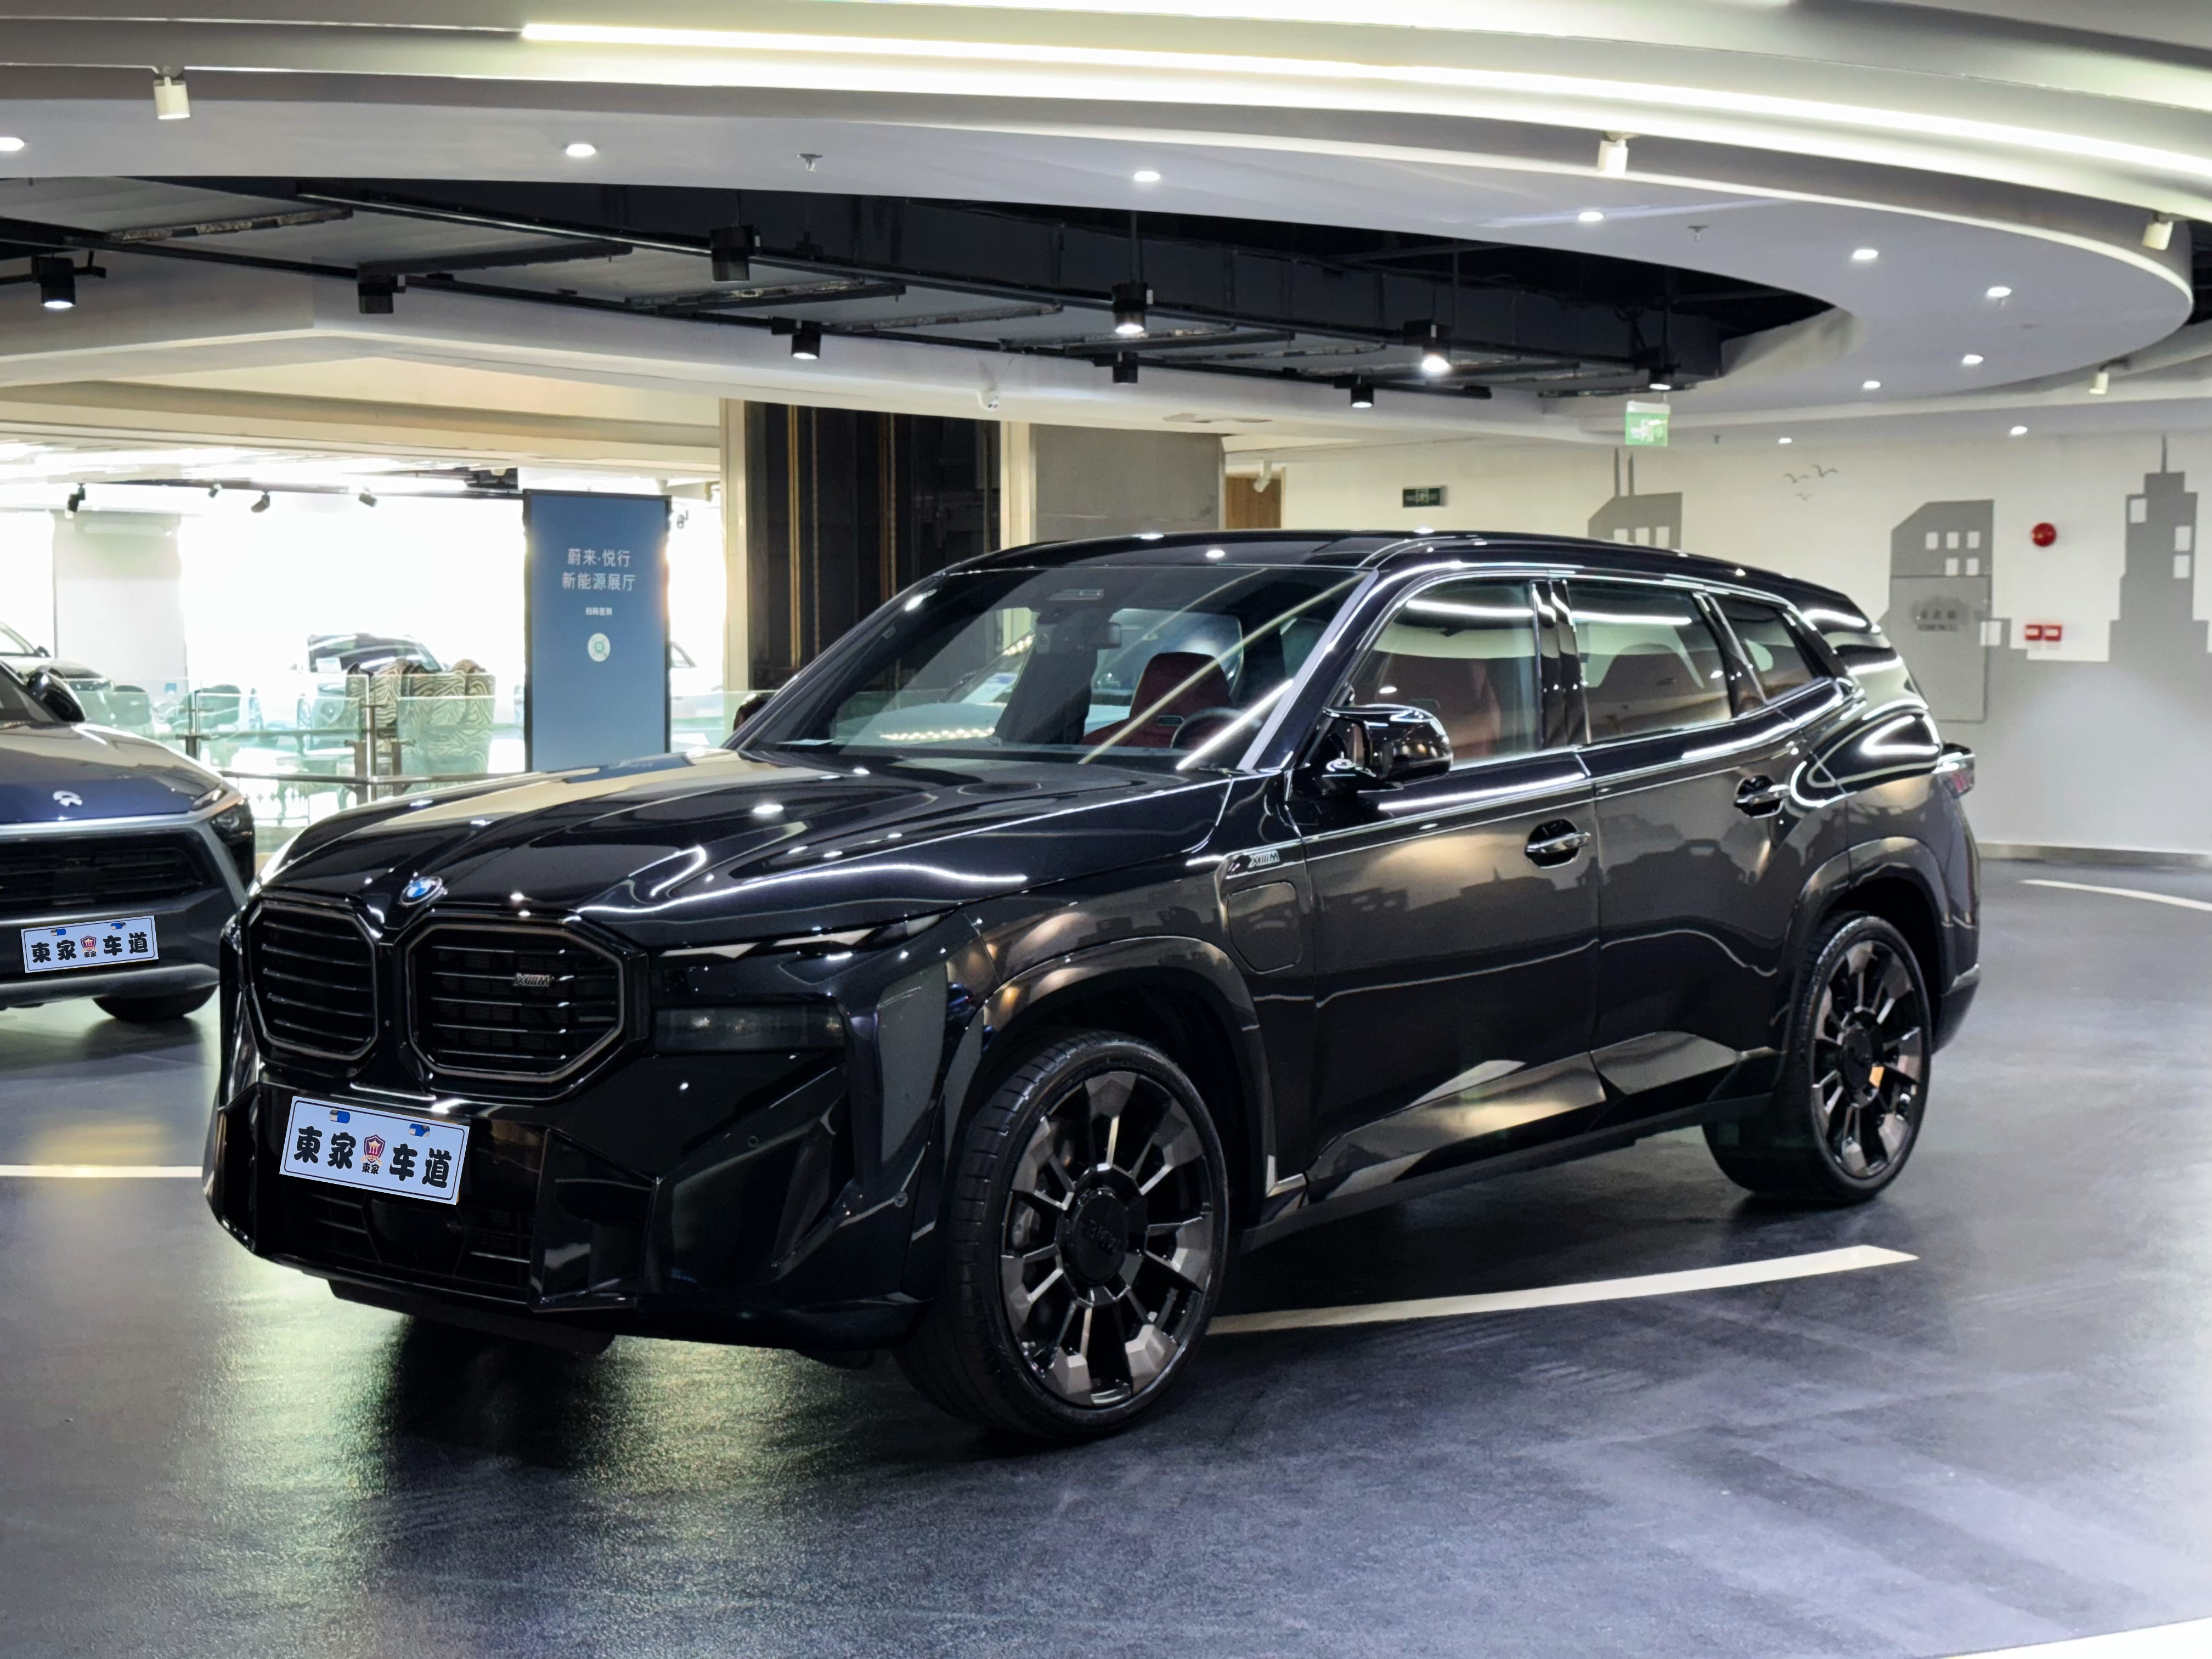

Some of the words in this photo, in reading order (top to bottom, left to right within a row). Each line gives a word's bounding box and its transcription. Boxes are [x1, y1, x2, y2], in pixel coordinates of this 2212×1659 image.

[561, 571, 636, 591] 新能源展厅
